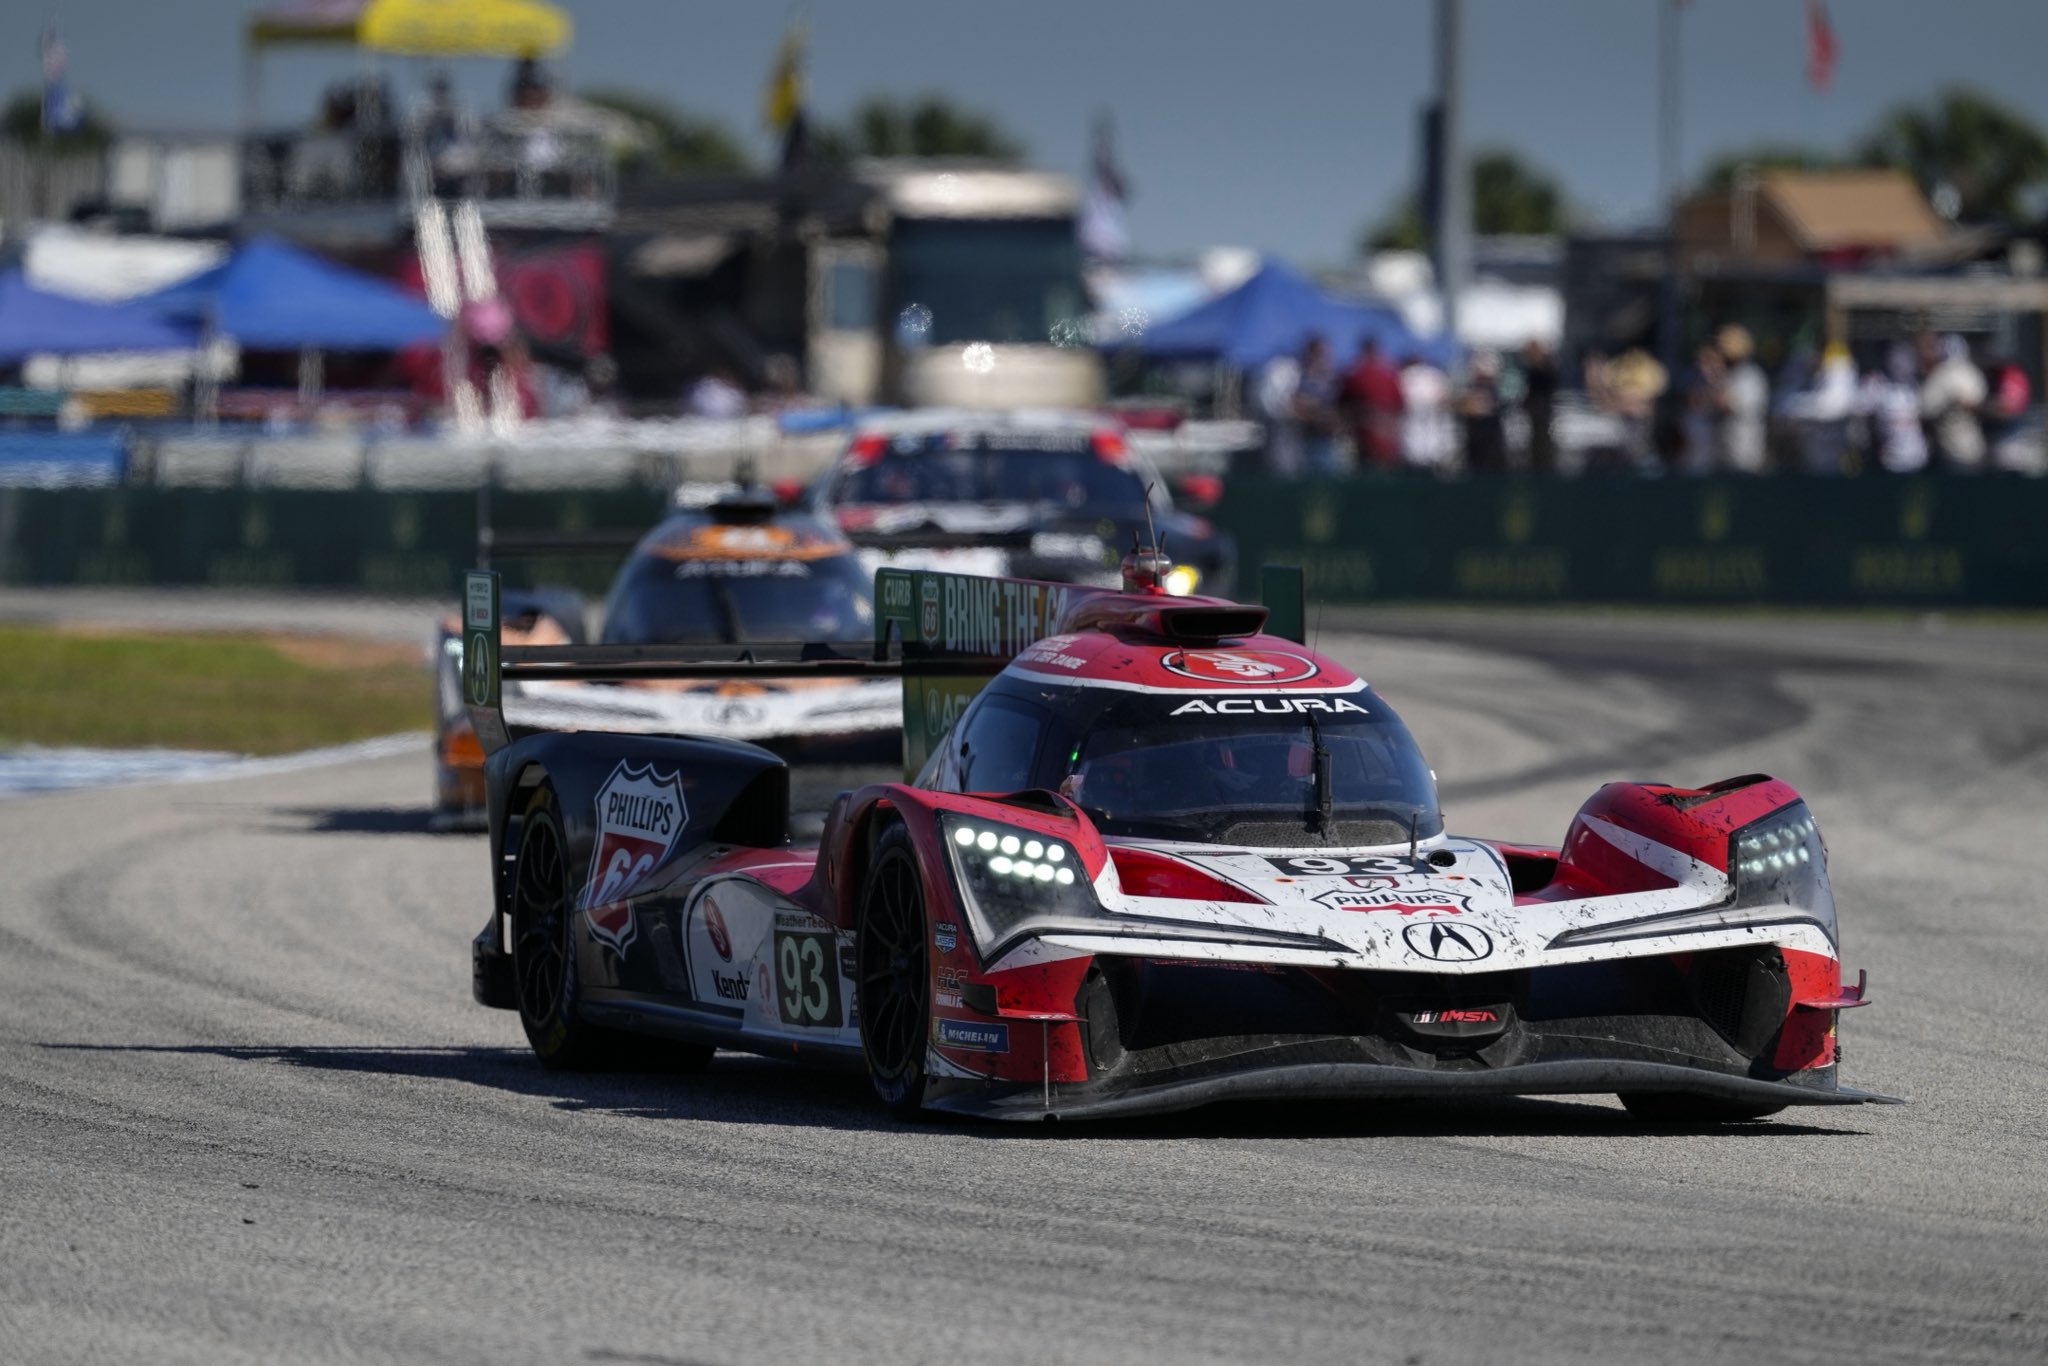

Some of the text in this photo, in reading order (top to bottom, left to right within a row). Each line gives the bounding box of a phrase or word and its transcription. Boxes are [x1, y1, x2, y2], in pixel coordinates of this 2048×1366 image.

[884, 578, 911, 607] CURB
[924, 605, 937, 632] 66
[945, 577, 1000, 657] BRING
[1003, 583, 1040, 657] THE
[1169, 698, 1371, 716] ACURA
[607, 791, 674, 836] PHILLIPS
[1287, 856, 1416, 876] 93
[1333, 888, 1453, 906] PHILLIPS
[781, 936, 829, 1021] 93
[1439, 1009, 1499, 1023] IMSA
[948, 1028, 999, 1044] MICHELIN
